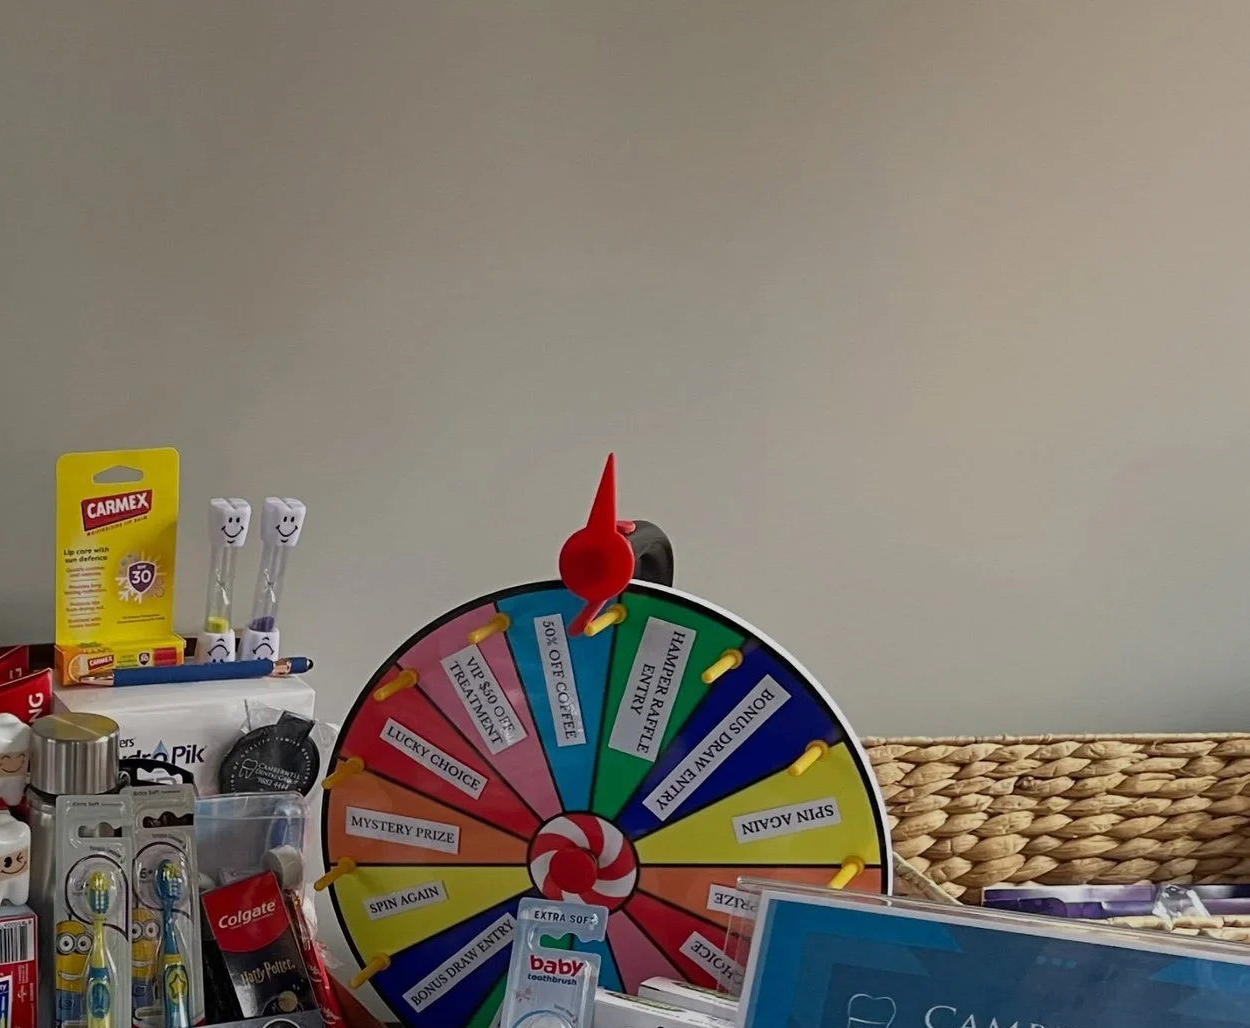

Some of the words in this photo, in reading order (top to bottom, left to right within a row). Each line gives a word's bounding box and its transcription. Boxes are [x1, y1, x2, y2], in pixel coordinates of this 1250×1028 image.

[87, 492, 150, 520] CARMEX
[75, 547, 92, 555] care
[131, 570, 151, 584] 30
[542, 620, 559, 648] 50%
[548, 648, 566, 679] OFF
[657, 630, 686, 694] HAMPER
[449, 660, 504, 746] TREATMENT
[465, 656, 487, 682] VIP
[478, 679, 500, 707] $50
[493, 704, 517, 734] OFF
[630, 663, 655, 716] ENTRY
[555, 681, 579, 740] COFFEE
[636, 691, 664, 756] RAFFLE
[729, 687, 776, 735] BONUS
[386, 725, 431, 760] LUCKY
[429, 751, 482, 792] CHOICE
[693, 732, 734, 774] DRAW
[656, 766, 697, 812] ENTRY
[741, 812, 793, 836] AGAIN
[795, 803, 835, 824] SPIN
[351, 815, 414, 837] MYSTERY
[415, 826, 455, 844] PRIZE
[218, 900, 277, 929] Colgate
[368, 896, 398, 915] SPIN
[399, 885, 440, 907] AGAIN
[534, 909, 566, 924] EXTRA
[240, 963, 266, 988] Harry
[265, 958, 294, 980] Potter
[410, 974, 449, 1008] BONUS
[446, 946, 480, 981] DRAW
[476, 918, 516, 955] ENTRY
[529, 954, 584, 977] baby
[527, 973, 578, 986] toothbrush
